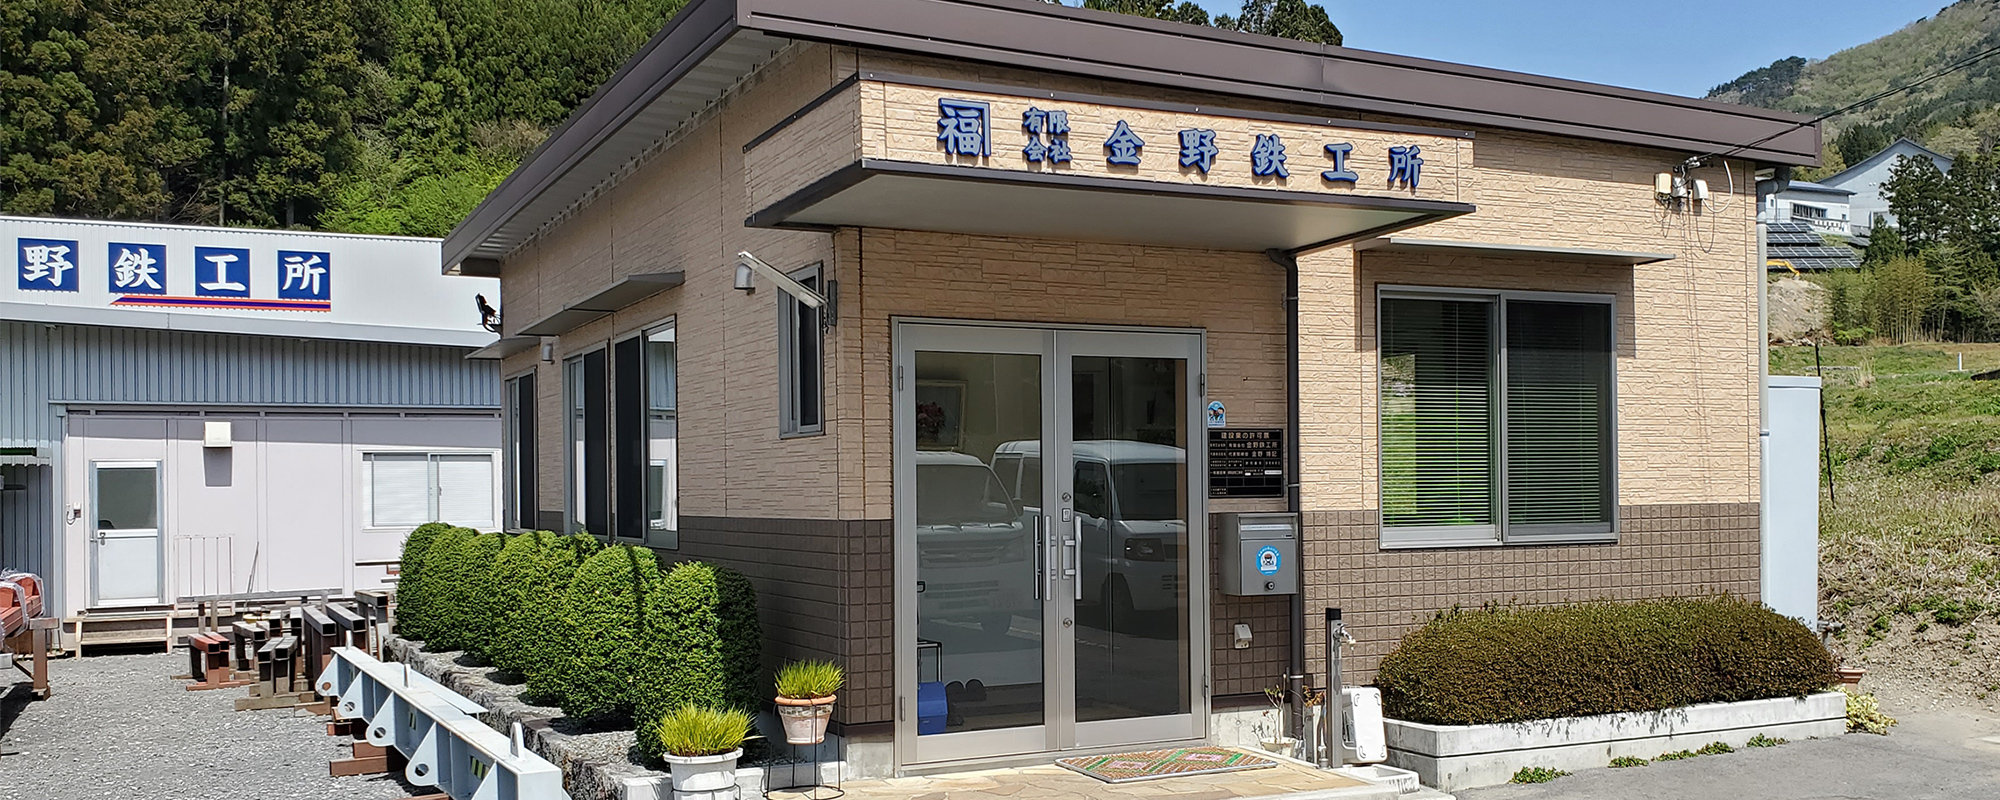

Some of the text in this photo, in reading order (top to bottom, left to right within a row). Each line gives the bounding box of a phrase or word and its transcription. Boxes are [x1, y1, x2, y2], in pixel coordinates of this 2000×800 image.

[1023, 107, 1070, 135] 有限
[1023, 136, 1072, 164] 会社
[1103, 118, 1424, 188] 金野鉄工所
[22, 243, 328, 296] 野鉄工所
